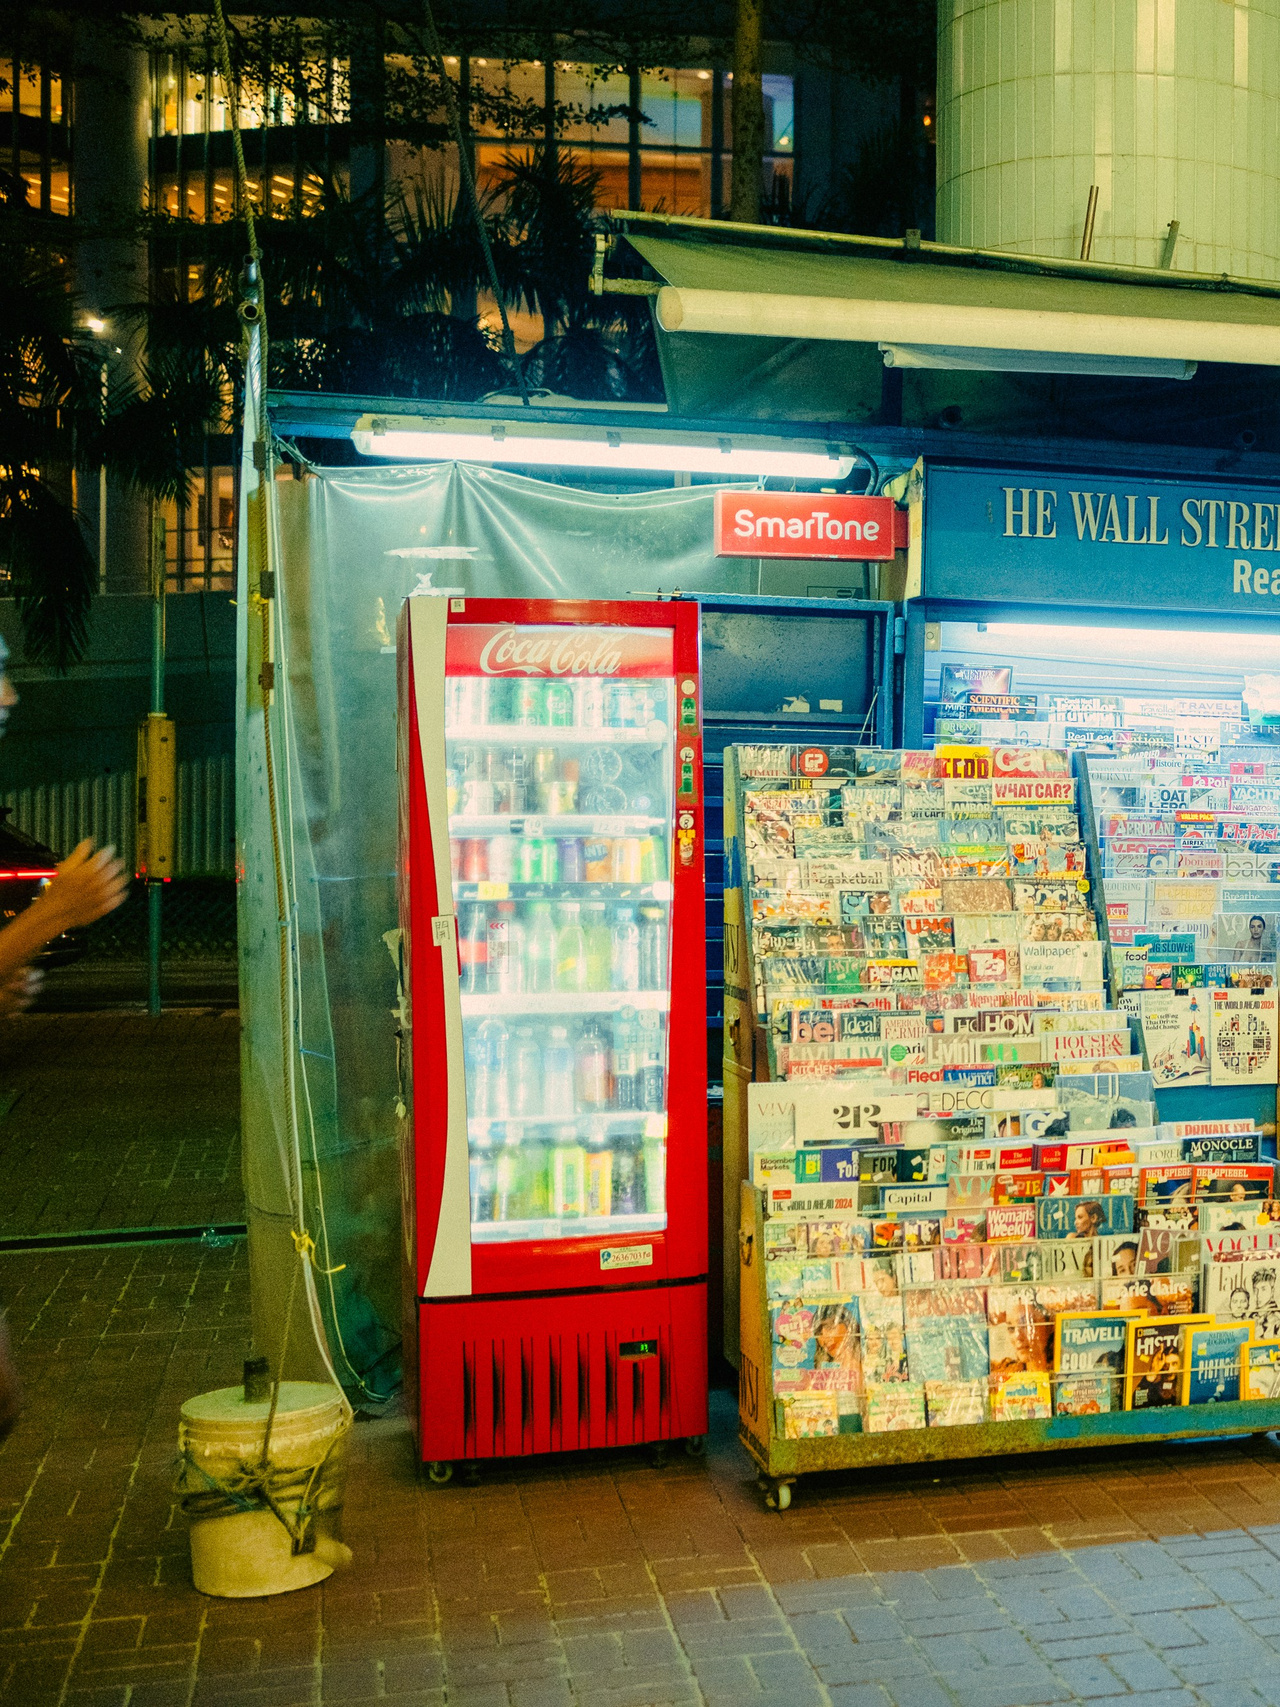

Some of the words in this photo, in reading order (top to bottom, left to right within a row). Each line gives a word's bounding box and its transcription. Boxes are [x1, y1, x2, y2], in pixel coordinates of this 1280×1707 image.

[735, 509, 881, 543] SmarTone
[1070, 490, 1169, 549] WALL
[970, 695, 1020, 706] SCIENTIFIC
[970, 706, 1020, 714] AMERICAN
[1091, 773, 1135, 782] OURNAL
[995, 783, 1032, 799] WHAT
[1035, 782, 1072, 799] CAR?
[1005, 820, 1065, 836] Golfer
[1103, 883, 1141, 891] OLOURING
[1161, 942, 1194, 953] SLOWER
[1214, 1001, 1223, 1009] THE
[1224, 1001, 1243, 1009] WORLD
[1244, 1001, 1260, 1009] AHEAD
[1261, 1000, 1275, 1009] 2024
[843, 1016, 876, 1034] Ideal
[1055, 1034, 1109, 1050] HOUSE
[1111, 1034, 1123, 1048] &
[832, 1104, 881, 1129] 212
[968, 1117, 984, 1126] The
[951, 1125, 983, 1137] Originals
[1190, 1138, 1254, 1152] MONOCLE
[1001, 1157, 1032, 1165] Economist
[1149, 1149, 1182, 1161] FOREI
[838, 1160, 859, 1178] FOR
[872, 1157, 897, 1173] FOR
[1145, 1168, 1162, 1178] DER
[1164, 1167, 1192, 1178] SPIEGE
[1196, 1168, 1212, 1178] DER
[1213, 1168, 1249, 1178] SPIEGEL
[812, 1199, 834, 1210] AHEAD
[834, 1198, 853, 1209] 2024
[888, 1191, 932, 1206] Capital
[989, 1222, 1033, 1238] Weekly
[1150, 1278, 1188, 1297] claire
[1062, 1352, 1095, 1371] COOL
